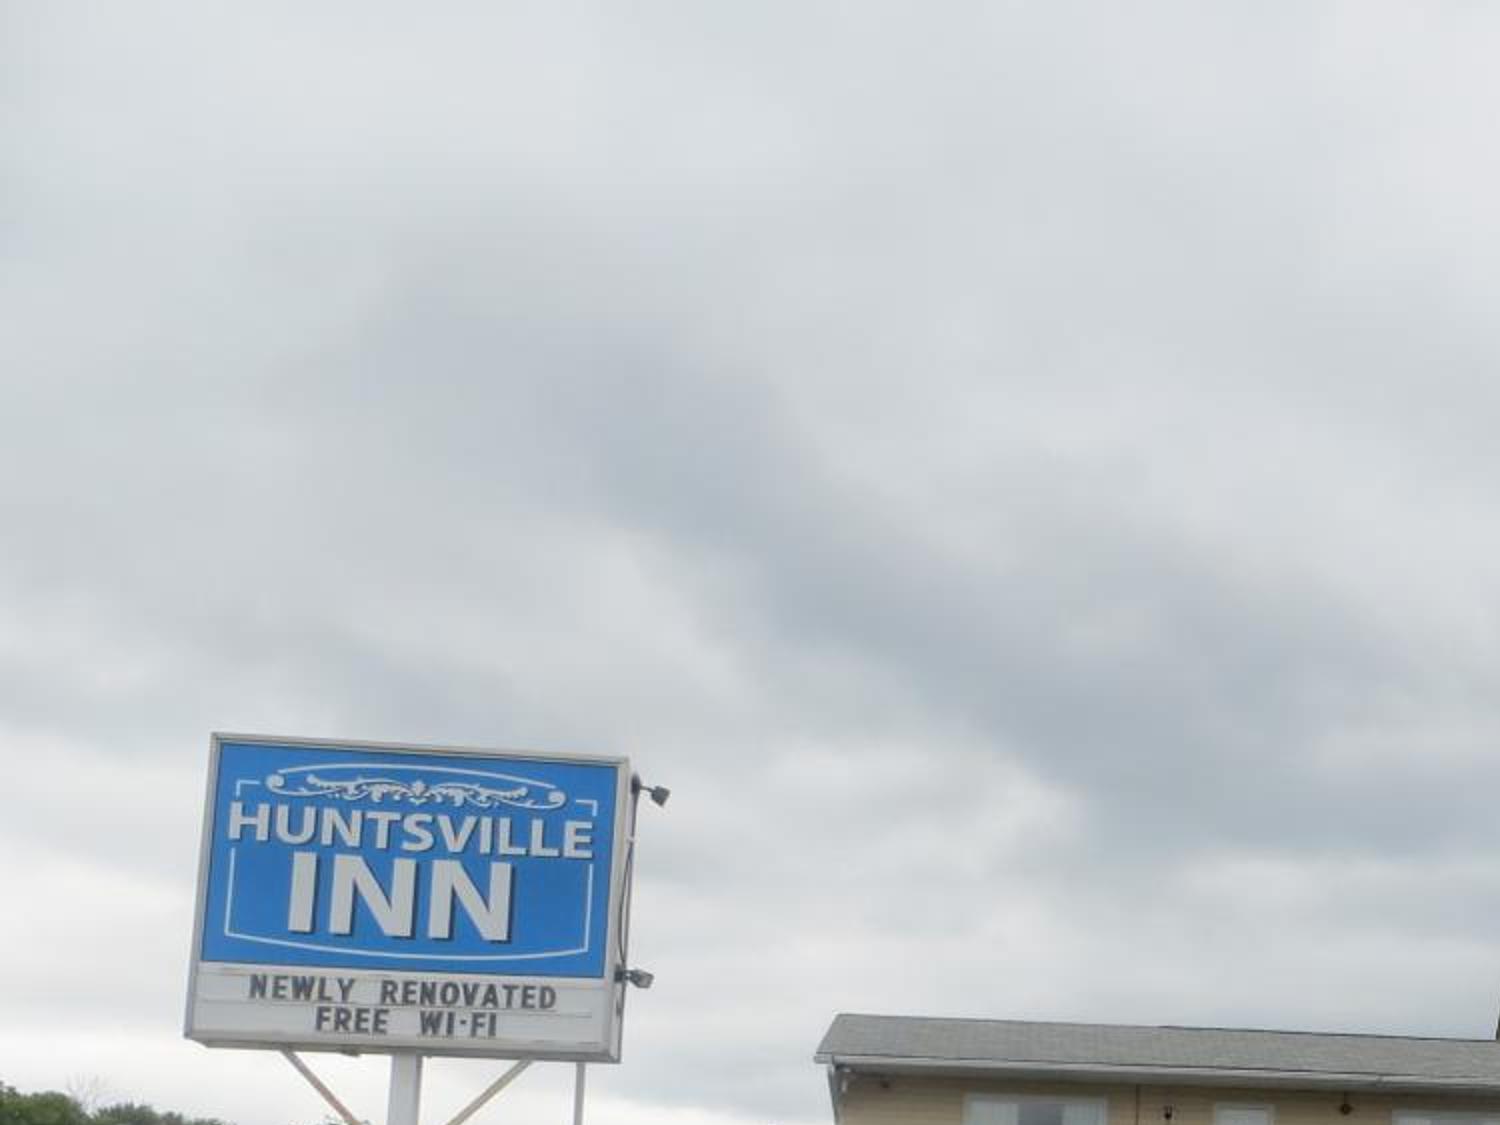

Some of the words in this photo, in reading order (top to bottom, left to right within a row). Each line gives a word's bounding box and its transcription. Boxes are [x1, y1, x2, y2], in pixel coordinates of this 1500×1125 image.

[227, 801, 594, 859] HUNTSVILLE
[287, 851, 513, 942] INN
[249, 974, 356, 1003] NEWLY
[380, 979, 557, 1010] RENOVATED
[315, 1006, 390, 1035] FREE
